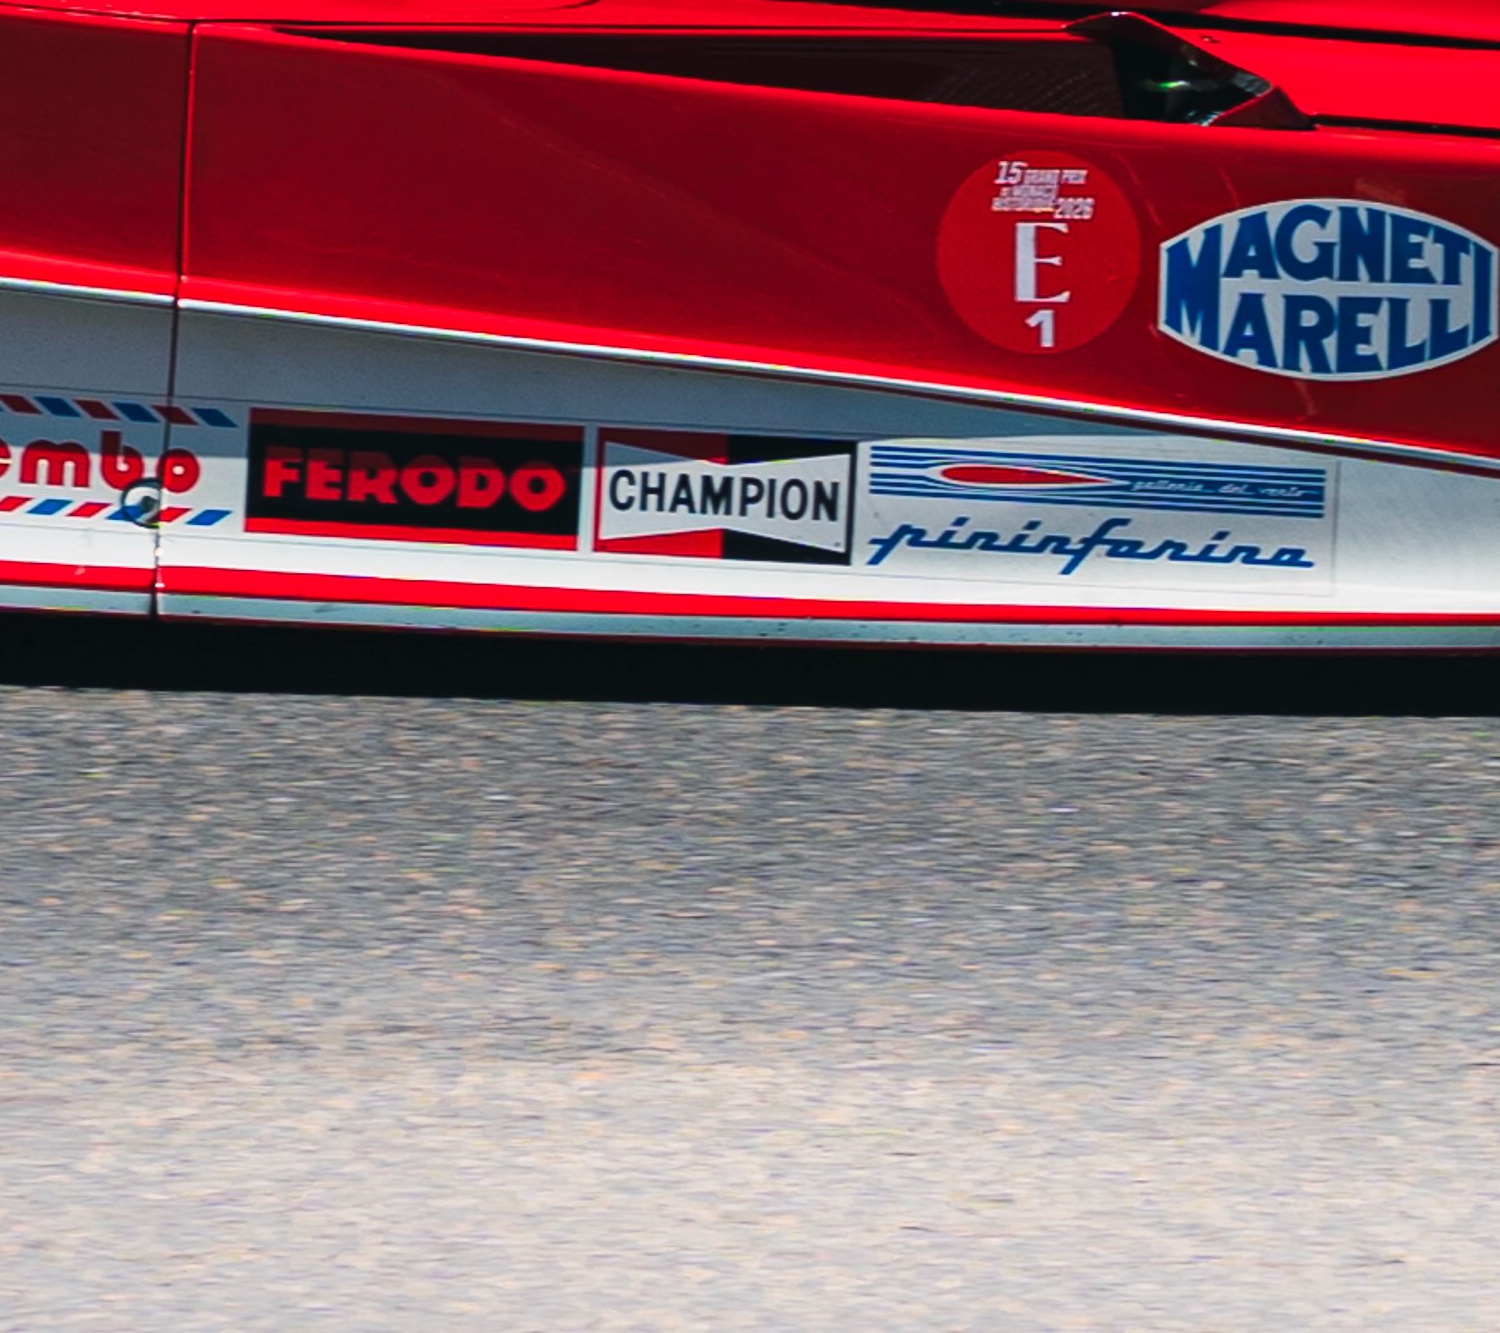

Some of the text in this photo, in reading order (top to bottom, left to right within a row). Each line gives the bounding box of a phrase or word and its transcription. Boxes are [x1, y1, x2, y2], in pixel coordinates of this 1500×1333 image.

[1014, 221, 1071, 303] E
[1163, 203, 1494, 288] MAGNETI
[1025, 309, 1055, 348] 1
[1163, 290, 1494, 375] MARELLI
[262, 444, 566, 512] FERODO
[609, 469, 840, 522] CHAMPION
[865, 516, 1315, 575] pininfarina
